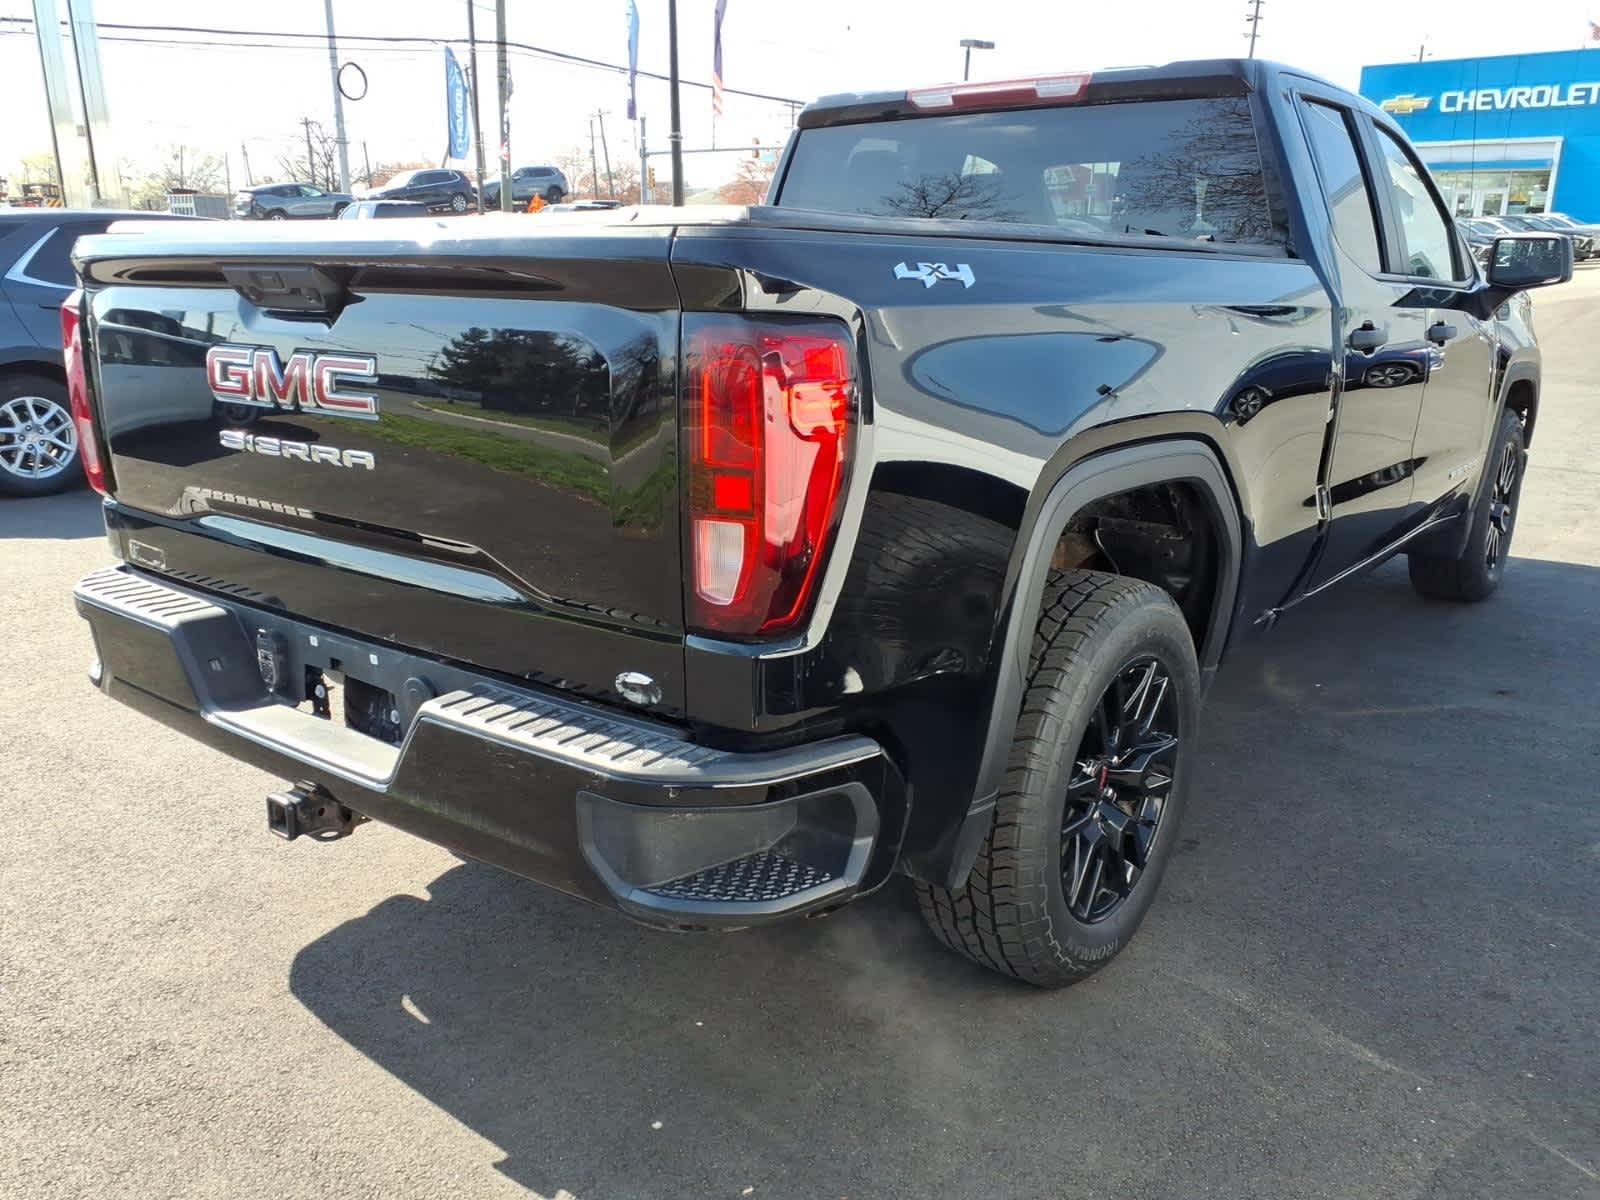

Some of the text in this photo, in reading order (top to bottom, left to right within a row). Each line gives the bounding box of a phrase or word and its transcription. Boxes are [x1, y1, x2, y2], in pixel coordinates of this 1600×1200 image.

[1440, 82, 1600, 113] CHEVROLET
[206, 342, 379, 421] GMC
[219, 428, 376, 471] SIERRA
